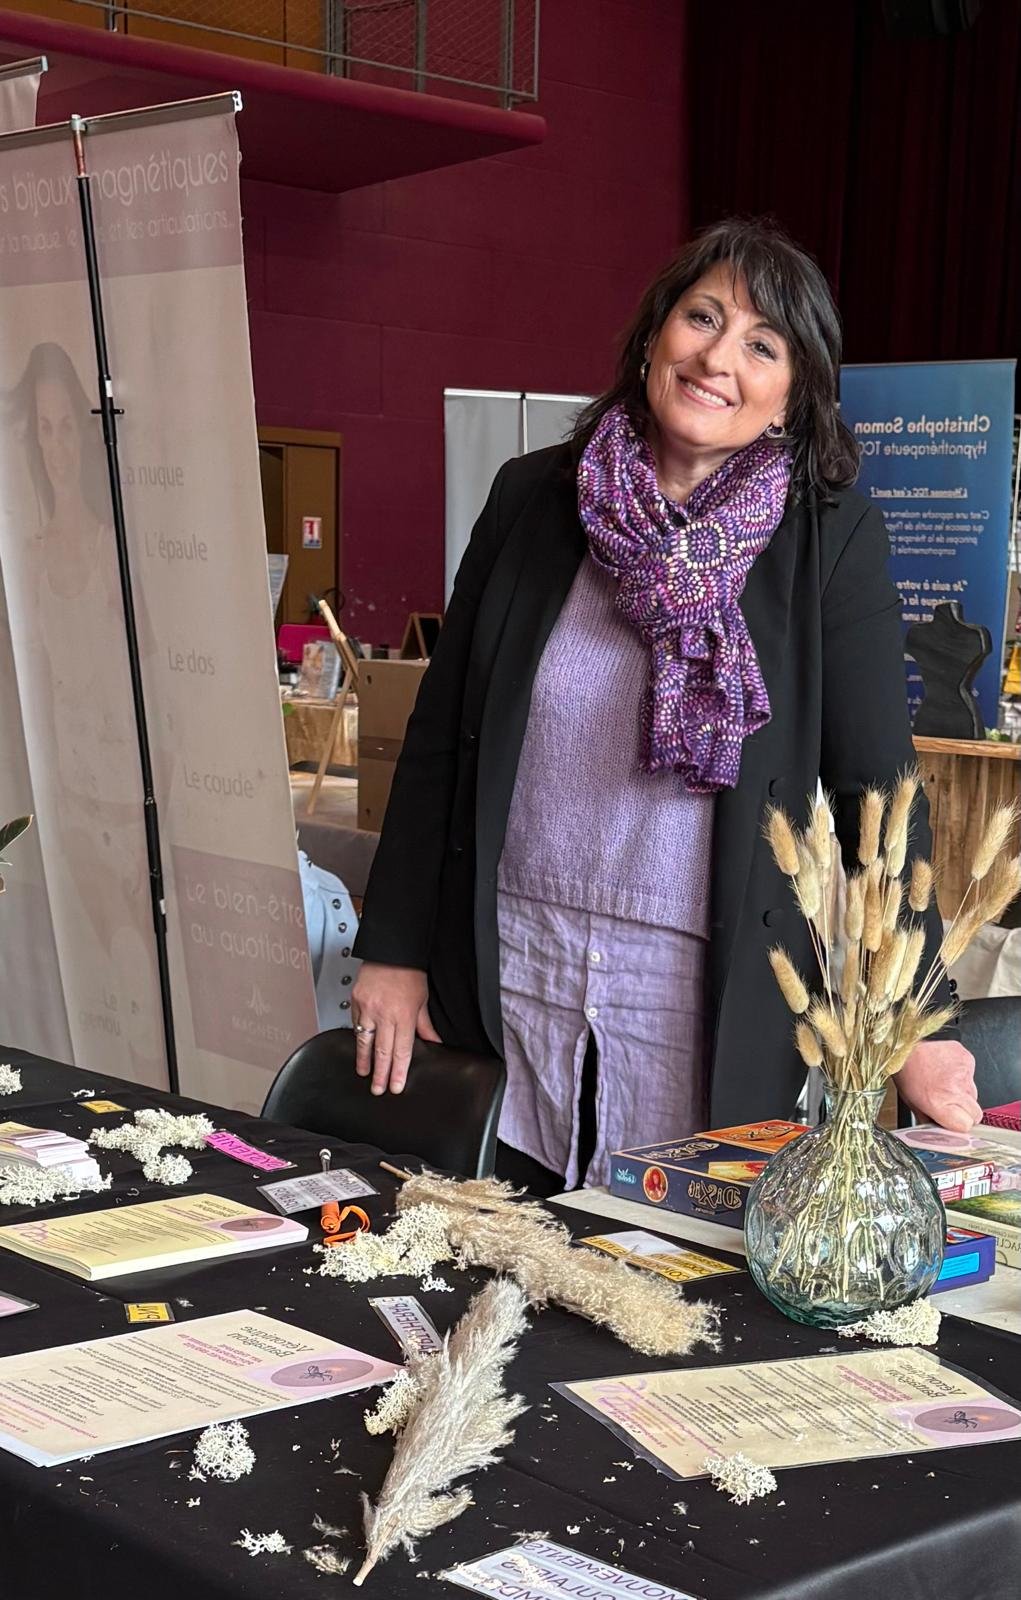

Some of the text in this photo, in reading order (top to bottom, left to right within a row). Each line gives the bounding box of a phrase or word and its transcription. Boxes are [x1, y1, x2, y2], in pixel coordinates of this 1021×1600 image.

[14, 169, 75, 216] bijoux
[140, 465, 184, 488] nuque
[168, 647, 216, 676] Le dos
[183, 762, 254, 798] Le coude
[184, 875, 304, 927] Le bien-être
[191, 922, 310, 974] au quotidien
